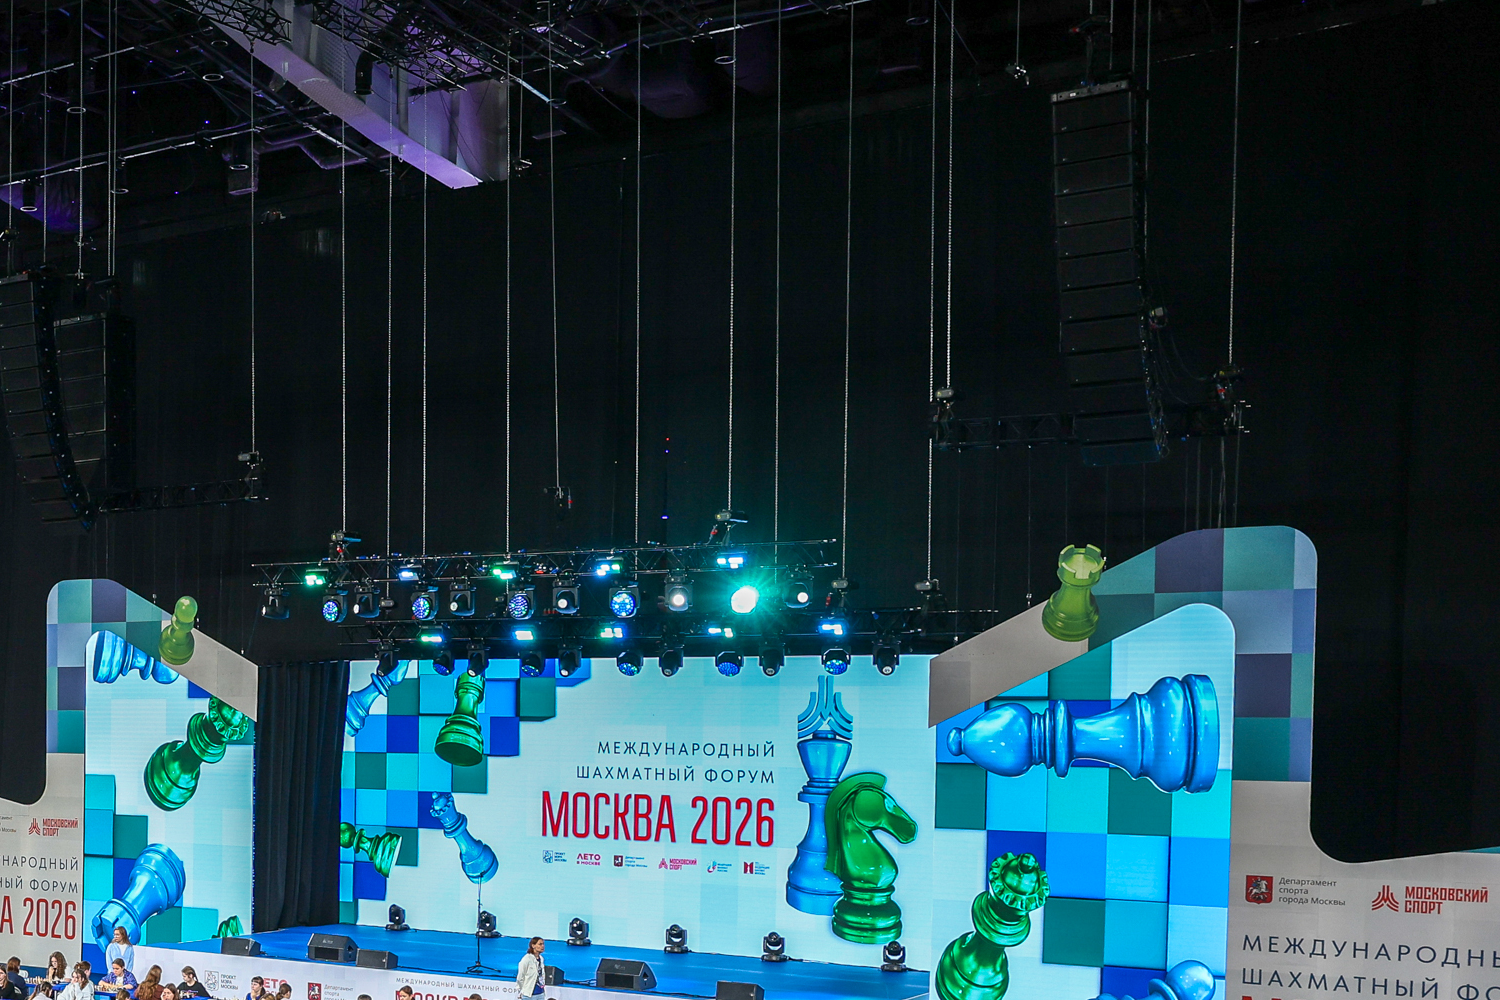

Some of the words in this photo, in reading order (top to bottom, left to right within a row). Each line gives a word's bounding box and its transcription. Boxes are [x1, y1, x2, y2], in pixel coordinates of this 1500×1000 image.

[597, 740, 775, 758] МЕЖДУНАРОДНЫЙ
[576, 765, 695, 781] ШАХМАТНЫЙ
[704, 768, 774, 784] ФОРУМ
[42, 818, 79, 828] МОСКОВСКИЙ
[541, 790, 676, 843] МОСКВА
[691, 795, 774, 847] 2026
[42, 827, 60, 837] СПОРТ
[577, 853, 601, 861] ЛЕТО
[29, 878, 79, 894] ФОРУМ
[1278, 877, 1337, 888] Департамент
[1278, 887, 1309, 896] спорта
[1405, 885, 1488, 903] МОСКОВСКИЙ
[1278, 896, 1308, 906] города
[1310, 897, 1346, 906] Москвы
[1405, 900, 1443, 915] СПОРТ
[22, 897, 77, 940] 2026
[263, 978, 288, 987] ЕТО
[395, 977, 455, 989] МЕЖДУНАРОДНЫЙ
[457, 982, 500, 993] ШАХМАТНЫЙ
[1242, 967, 1439, 999] ШАХМАТНЫЙ
